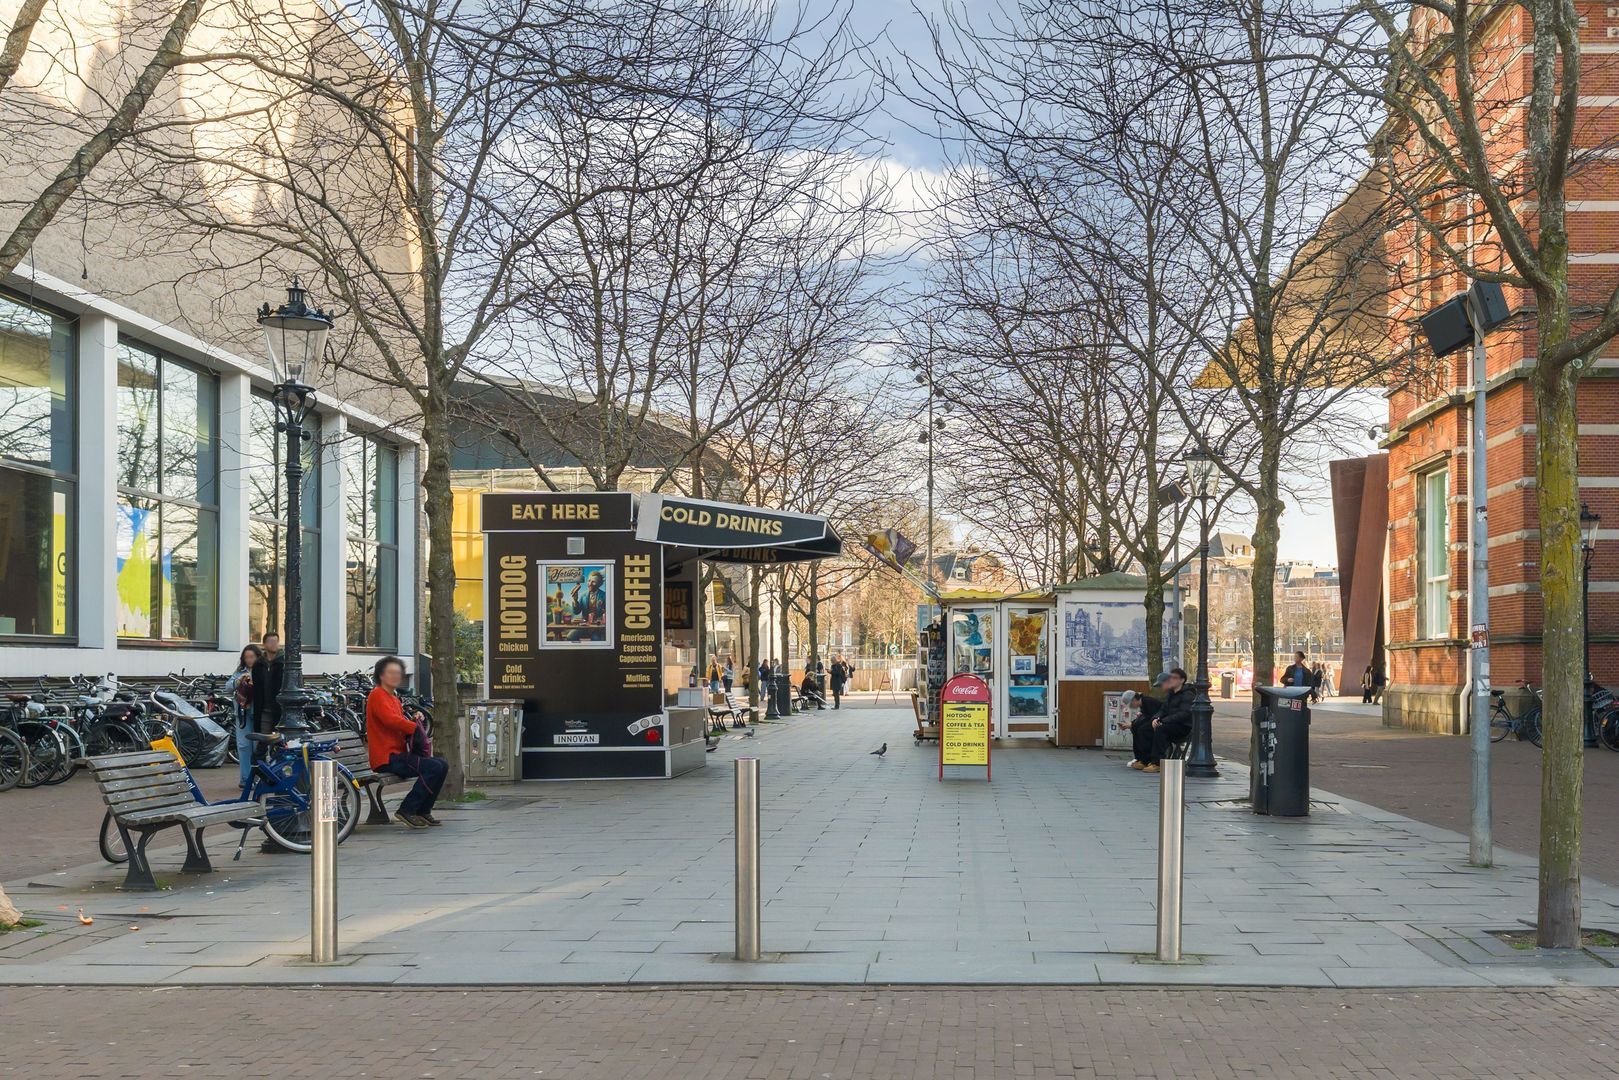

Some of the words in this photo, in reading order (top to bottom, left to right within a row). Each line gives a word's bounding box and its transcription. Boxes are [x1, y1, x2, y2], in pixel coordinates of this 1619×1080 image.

[511, 503, 546, 520] EAT
[551, 503, 600, 520] HERE
[661, 506, 711, 526] COLD
[716, 513, 782, 536] DRINKS
[500, 555, 527, 639] HOTDOG
[624, 554, 651, 630] COFFEE
[620, 634, 655, 642] Americano
[498, 642, 529, 653] Chicken
[623, 644, 653, 653] Espresso
[619, 654, 657, 664] Cappuccino
[505, 664, 523, 674] Cold
[502, 673, 527, 684] drinks
[625, 673, 651, 683] Muffins
[558, 735, 595, 743] INNOVAN
